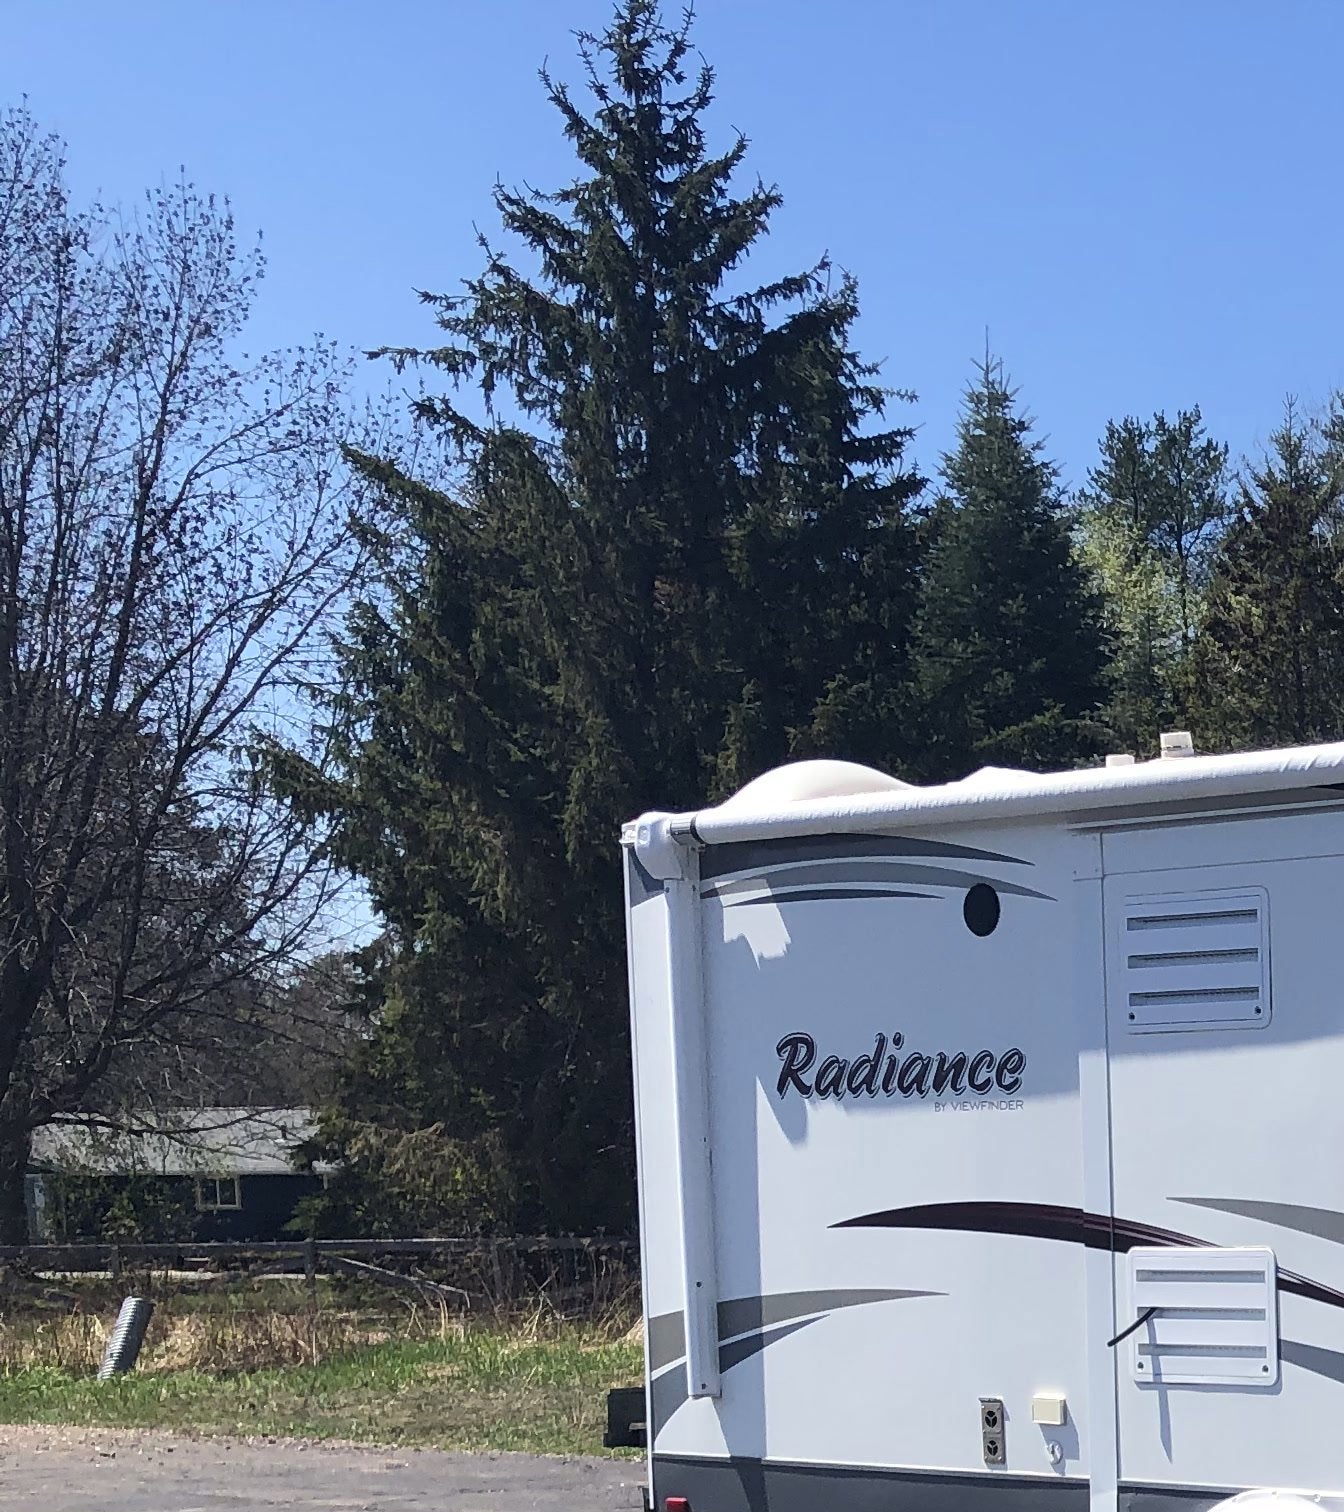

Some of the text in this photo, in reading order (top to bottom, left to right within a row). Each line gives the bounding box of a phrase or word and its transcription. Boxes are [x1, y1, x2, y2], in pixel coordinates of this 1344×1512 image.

[776, 1031, 1026, 1101] Radiance
[934, 1100, 1025, 1113] BY VIEWFINDER
